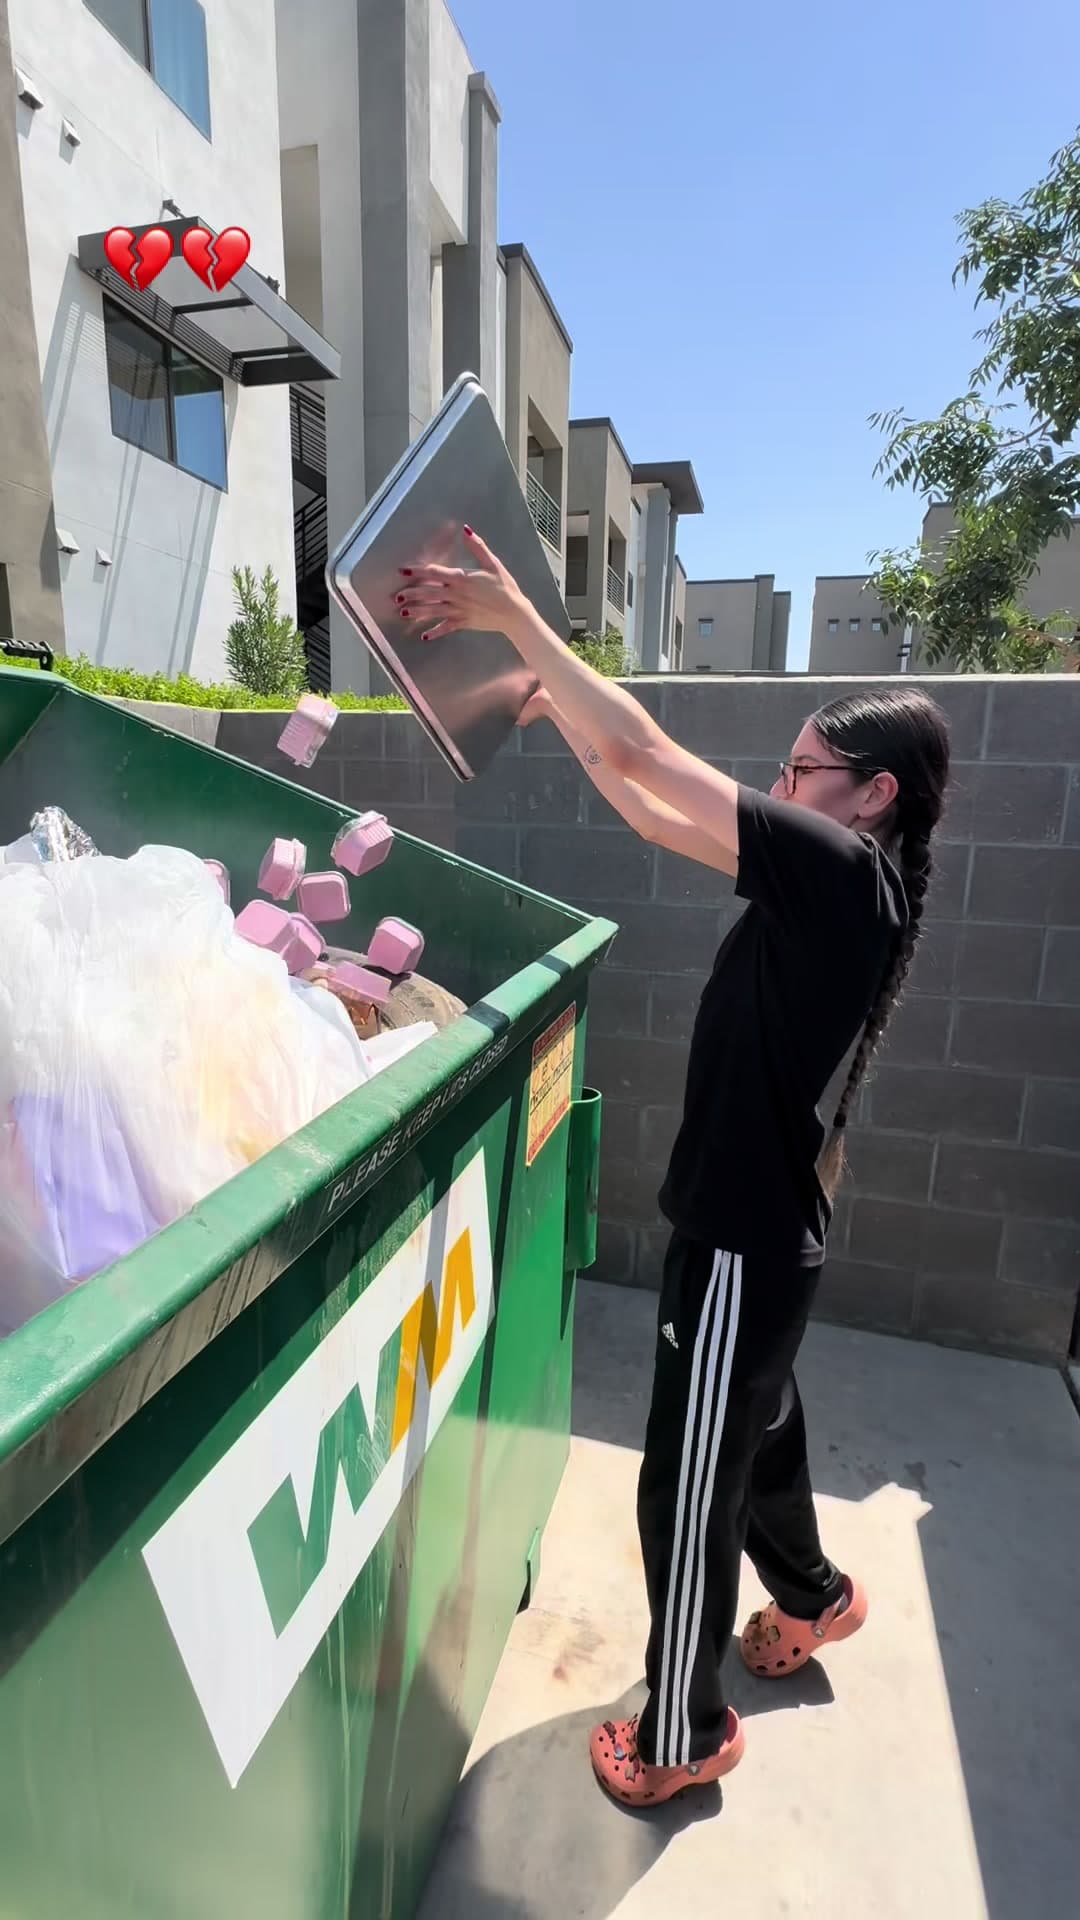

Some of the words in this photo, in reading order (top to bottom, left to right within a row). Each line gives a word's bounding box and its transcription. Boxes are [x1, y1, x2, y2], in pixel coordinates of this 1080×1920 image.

[327, 1130, 402, 1213] PLEASE
[402, 1095, 442, 1144] KEEP
[468, 1034, 509, 1081] CLOSED
[246, 1226, 476, 1640] WM
